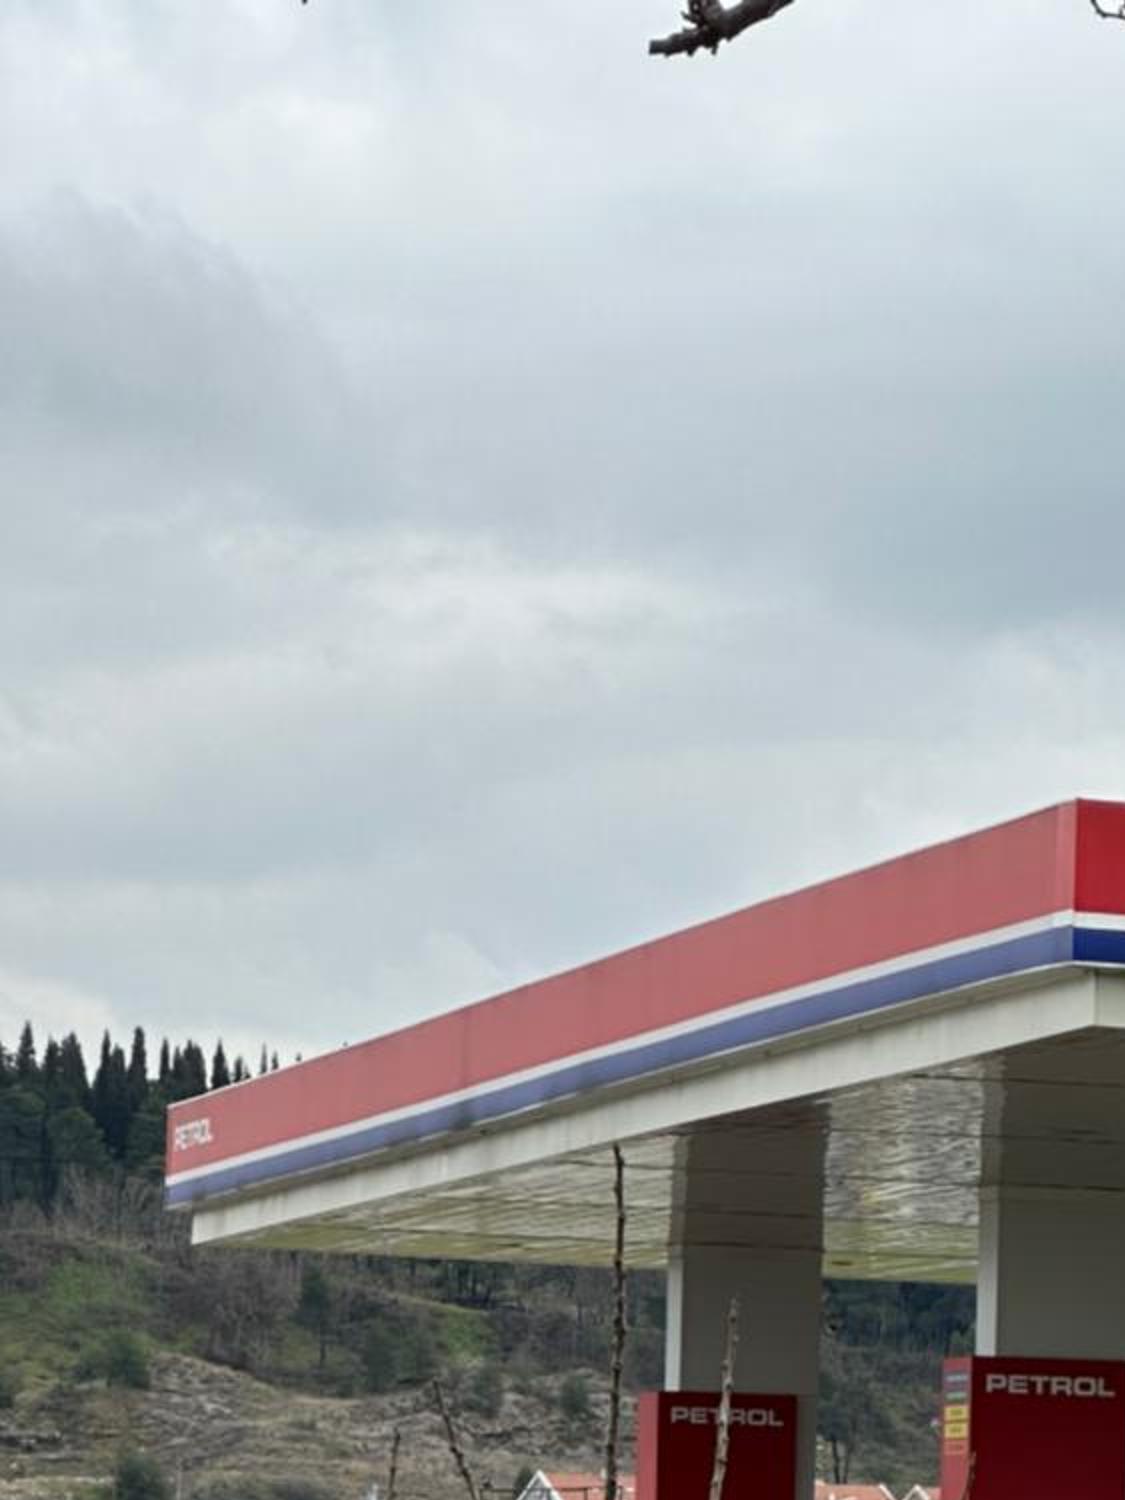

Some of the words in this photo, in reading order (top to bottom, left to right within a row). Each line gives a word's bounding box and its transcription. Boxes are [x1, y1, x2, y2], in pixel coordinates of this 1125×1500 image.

[174, 1118, 213, 1151] PETROL
[985, 1373, 1116, 1398] PETROL
[670, 1406, 785, 1427] PETROL
